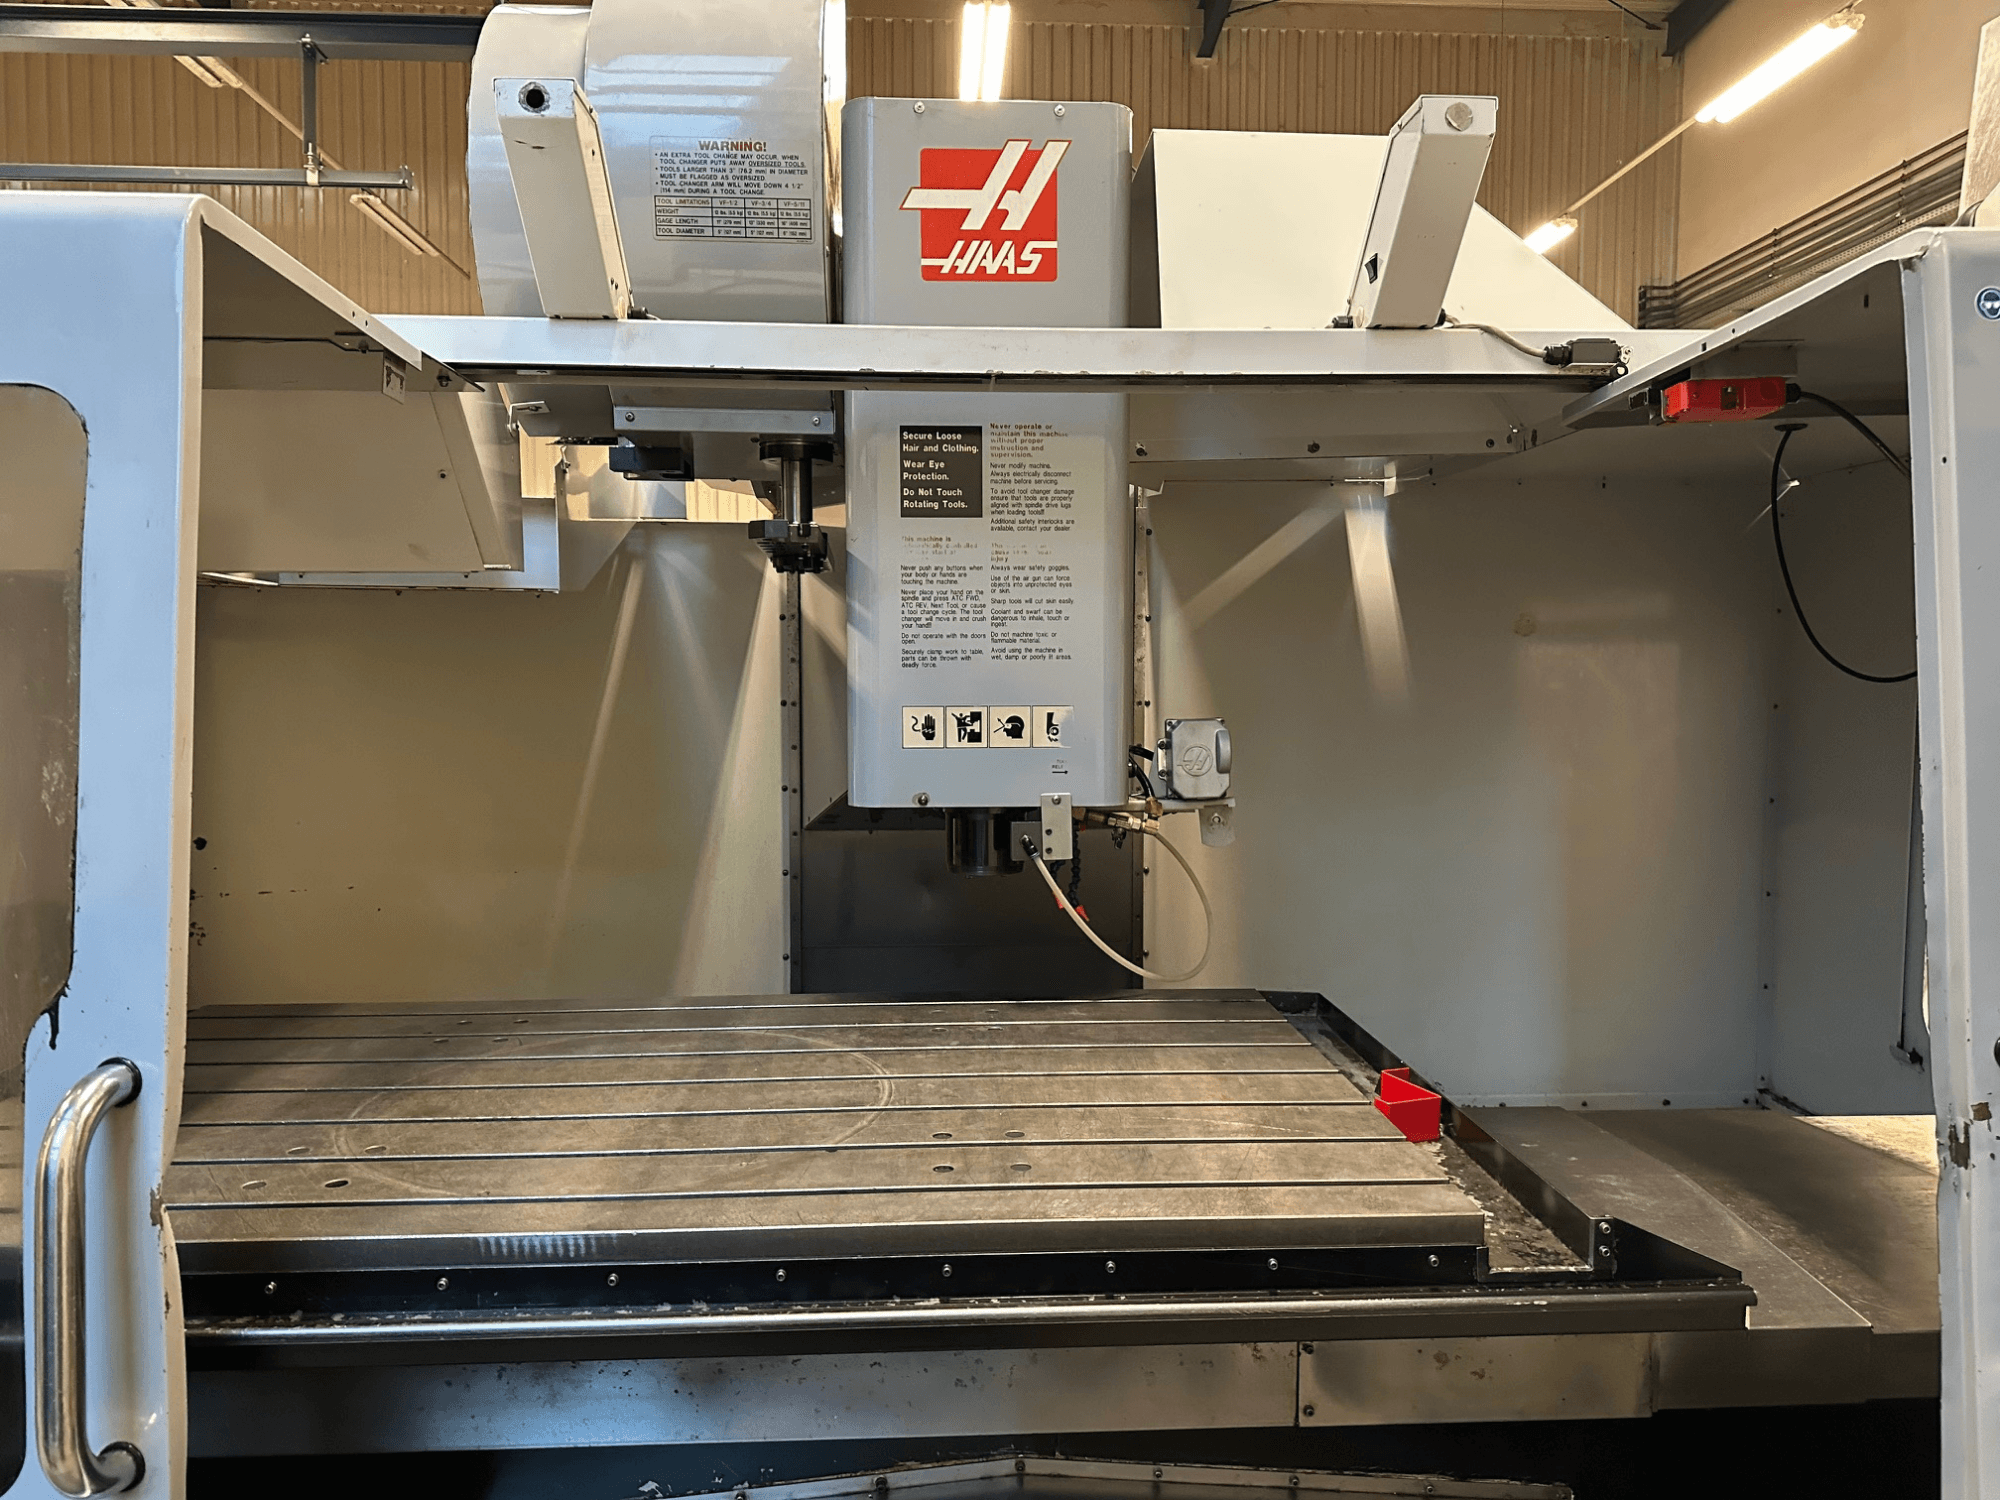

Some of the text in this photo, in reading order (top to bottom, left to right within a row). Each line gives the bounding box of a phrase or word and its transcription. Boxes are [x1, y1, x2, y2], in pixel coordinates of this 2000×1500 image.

[698, 141, 766, 151] WARNING!
[921, 240, 1057, 274] HAAS
[936, 432, 962, 440] Loose
[943, 445, 979, 454] Clothing.
[929, 460, 945, 469] Eye
[904, 501, 938, 509] Rotating
